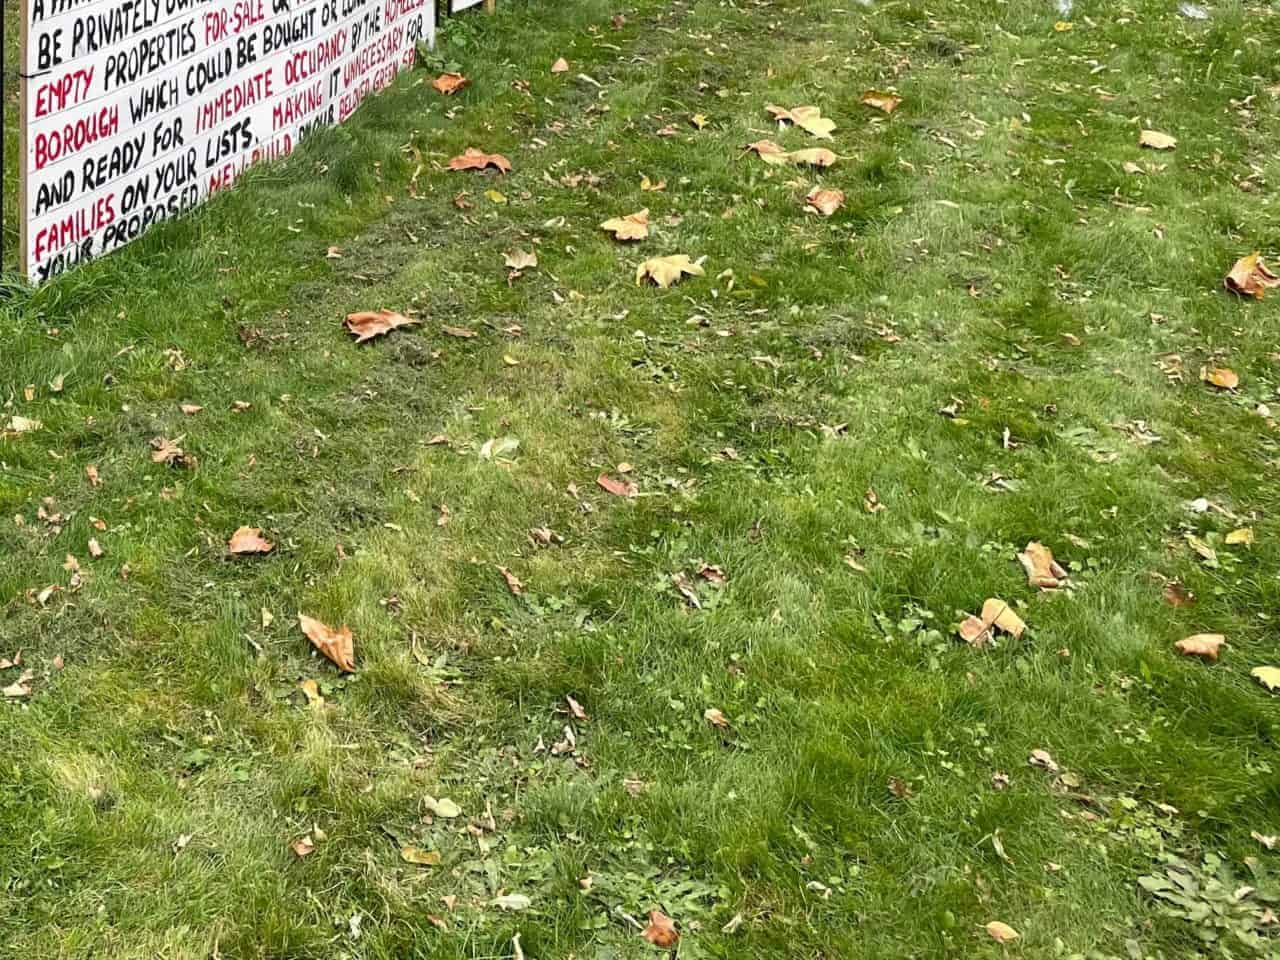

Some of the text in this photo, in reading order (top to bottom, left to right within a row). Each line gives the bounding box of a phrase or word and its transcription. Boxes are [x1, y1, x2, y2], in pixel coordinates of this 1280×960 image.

[35, 65, 94, 118] EMPTY
[104, 18, 196, 91] PROPERTIES
[35, 104, 119, 171] BOROUGH
[129, 77, 179, 125] WHICH
[186, 47, 232, 96] COULD
[236, 32, 257, 70] BE
[263, 7, 317, 55] BOUGHT
[35, 170, 75, 217] AND
[81, 132, 146, 192] READY
[152, 117, 184, 157] FOR
[196, 68, 273, 135] IMMEDIATE
[285, 29, 347, 86] OCCUPANCY
[351, 20, 363, 53] BY
[364, 6, 380, 40] THE
[37, 28, 63, 71] BE
[33, 193, 116, 263] FAMILIES
[121, 174, 149, 215] ON
[153, 147, 197, 200] YOUR
[273, 80, 323, 131] MAKING
[329, 66, 341, 99] IT
[344, 25, 406, 88] UNNECESSARY
[406, 13, 423, 44] FOR
[38, 237, 95, 284] YOUR
[312, 104, 334, 127] OUR
